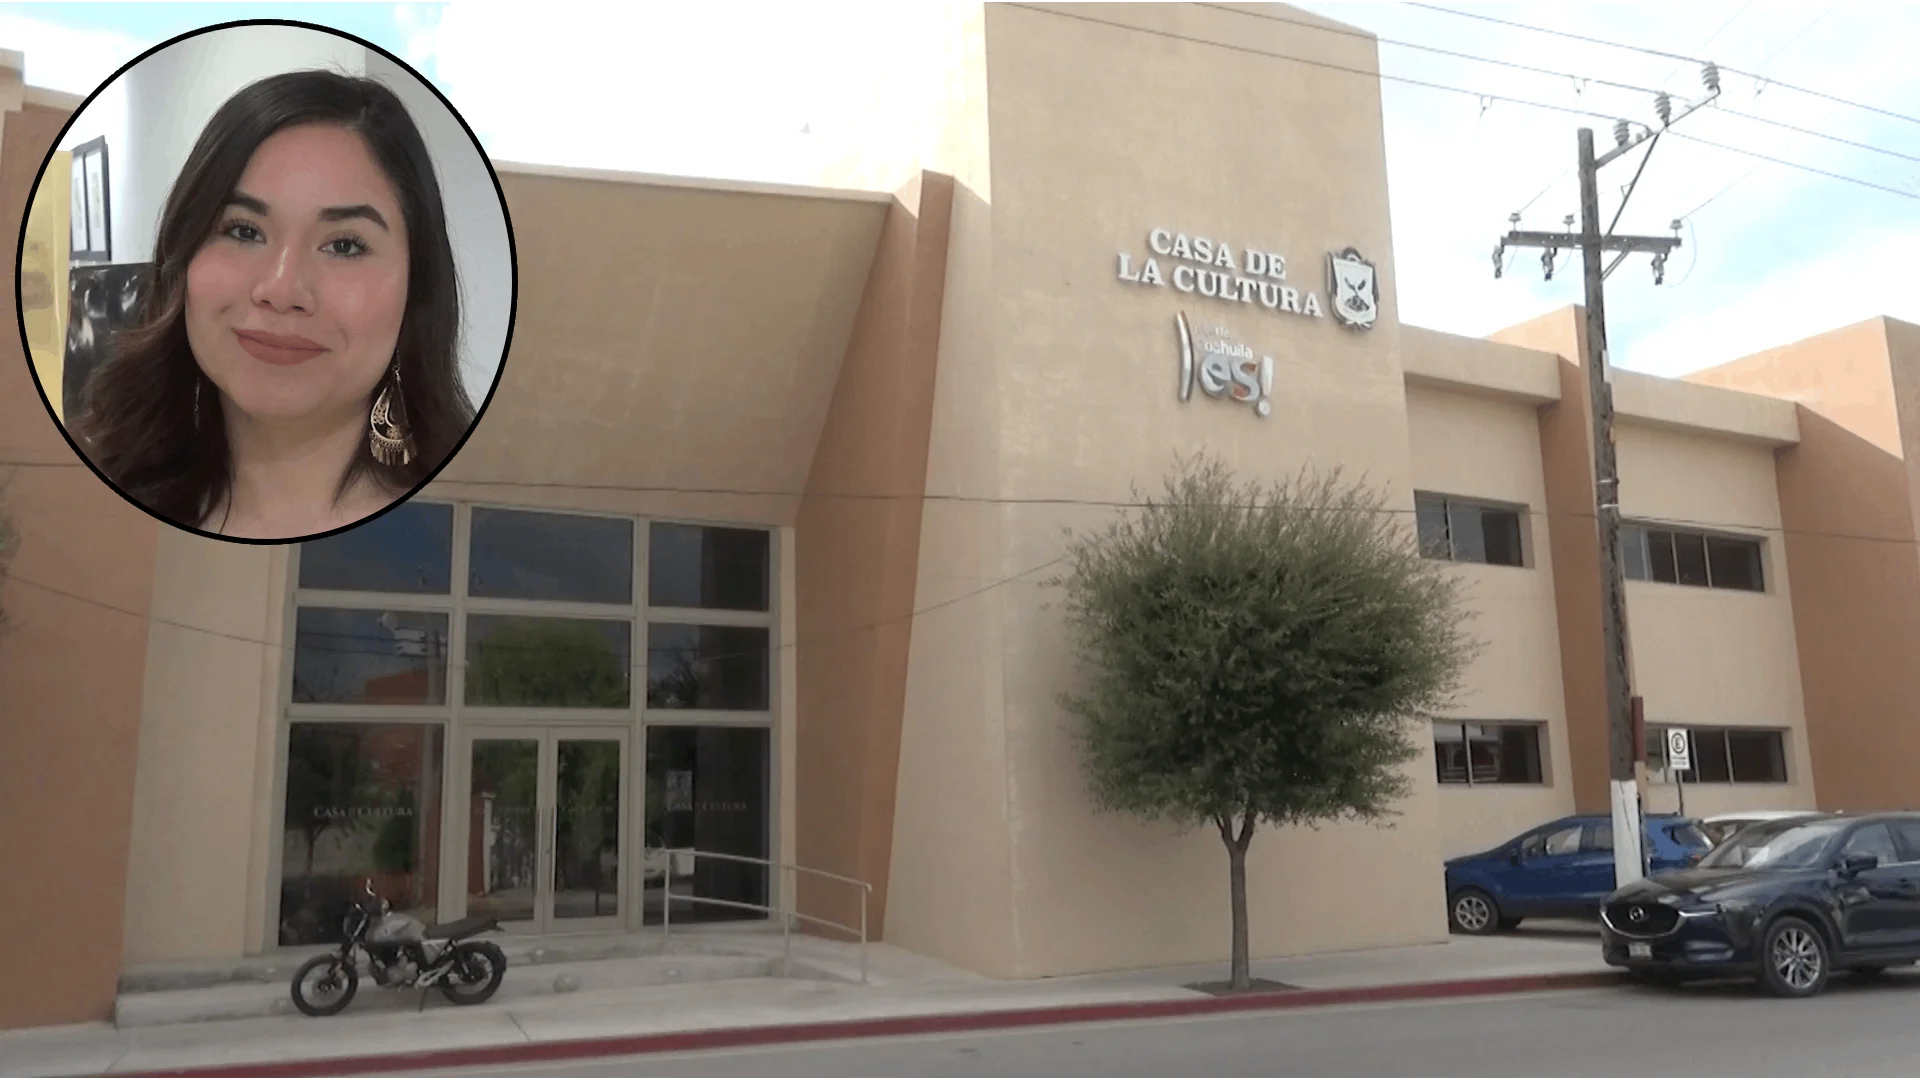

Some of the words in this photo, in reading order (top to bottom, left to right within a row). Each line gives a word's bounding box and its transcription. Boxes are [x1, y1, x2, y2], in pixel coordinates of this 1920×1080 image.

[1149, 227, 1235, 269] CASA
[1245, 248, 1287, 281] DE
[1117, 252, 1165, 286] LA
[1173, 264, 1324, 318] CULTURA
[1197, 339, 1254, 361] oahuila
